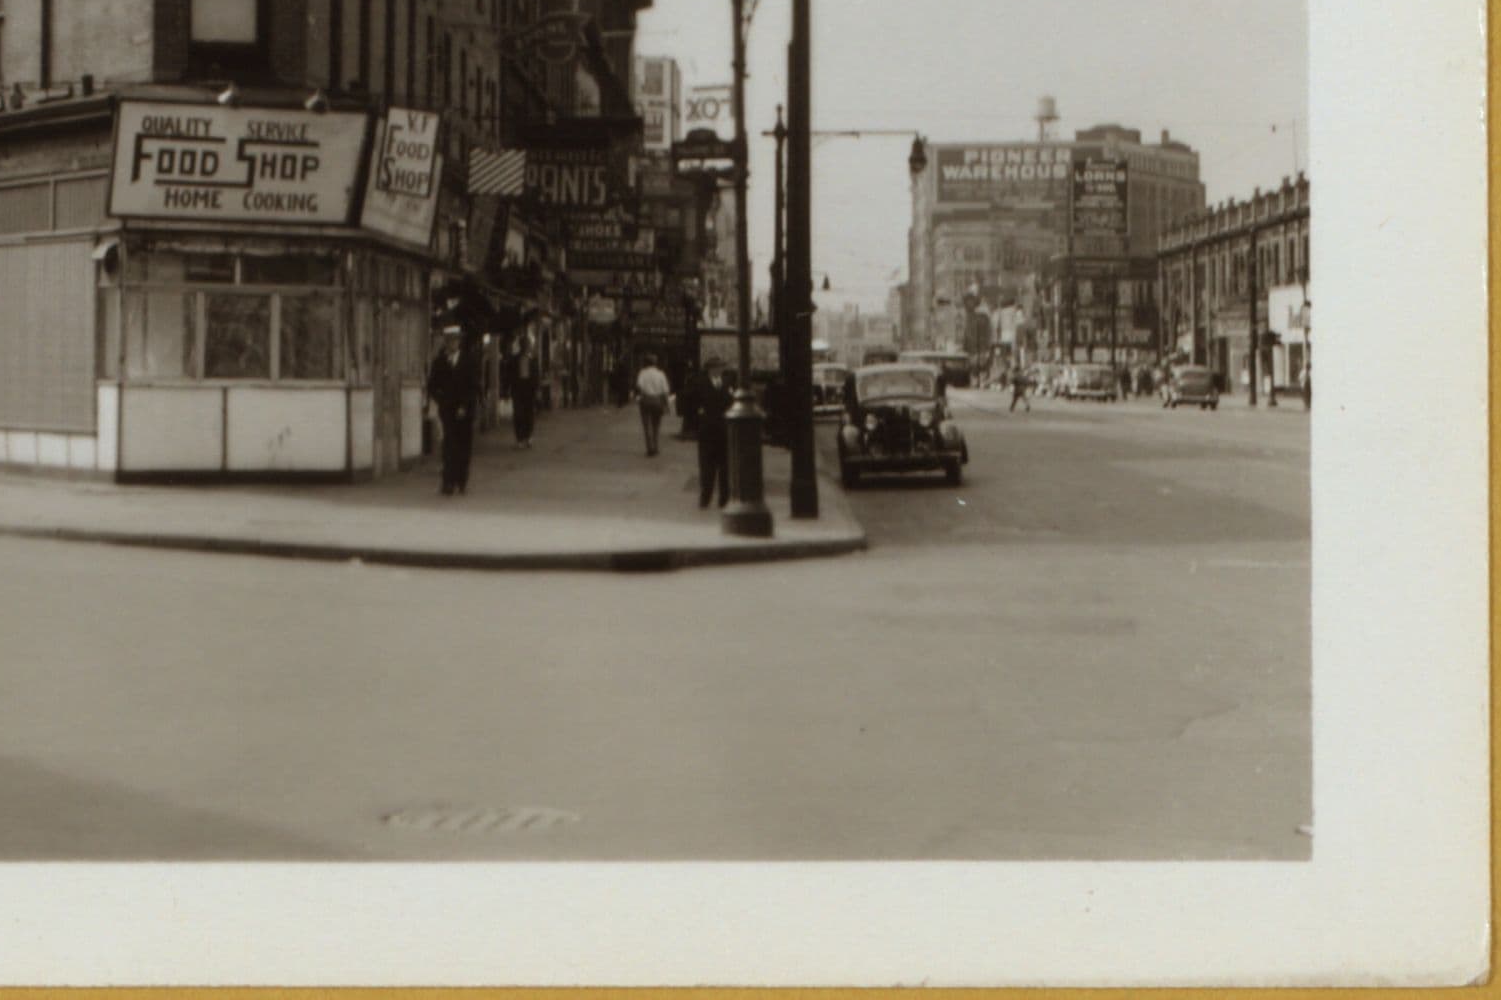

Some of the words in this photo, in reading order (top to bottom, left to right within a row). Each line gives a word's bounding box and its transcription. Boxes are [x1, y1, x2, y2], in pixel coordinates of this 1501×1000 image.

[141, 115, 213, 138] QUALITY
[246, 120, 308, 140] SERVICE
[387, 125, 430, 161] FOOD
[964, 149, 1071, 164] PIONEER
[131, 134, 227, 183] FOOD
[237, 137, 320, 189] SHOP
[382, 157, 429, 191] SHOP
[164, 189, 222, 209] HOME
[242, 192, 319, 213] COOKING
